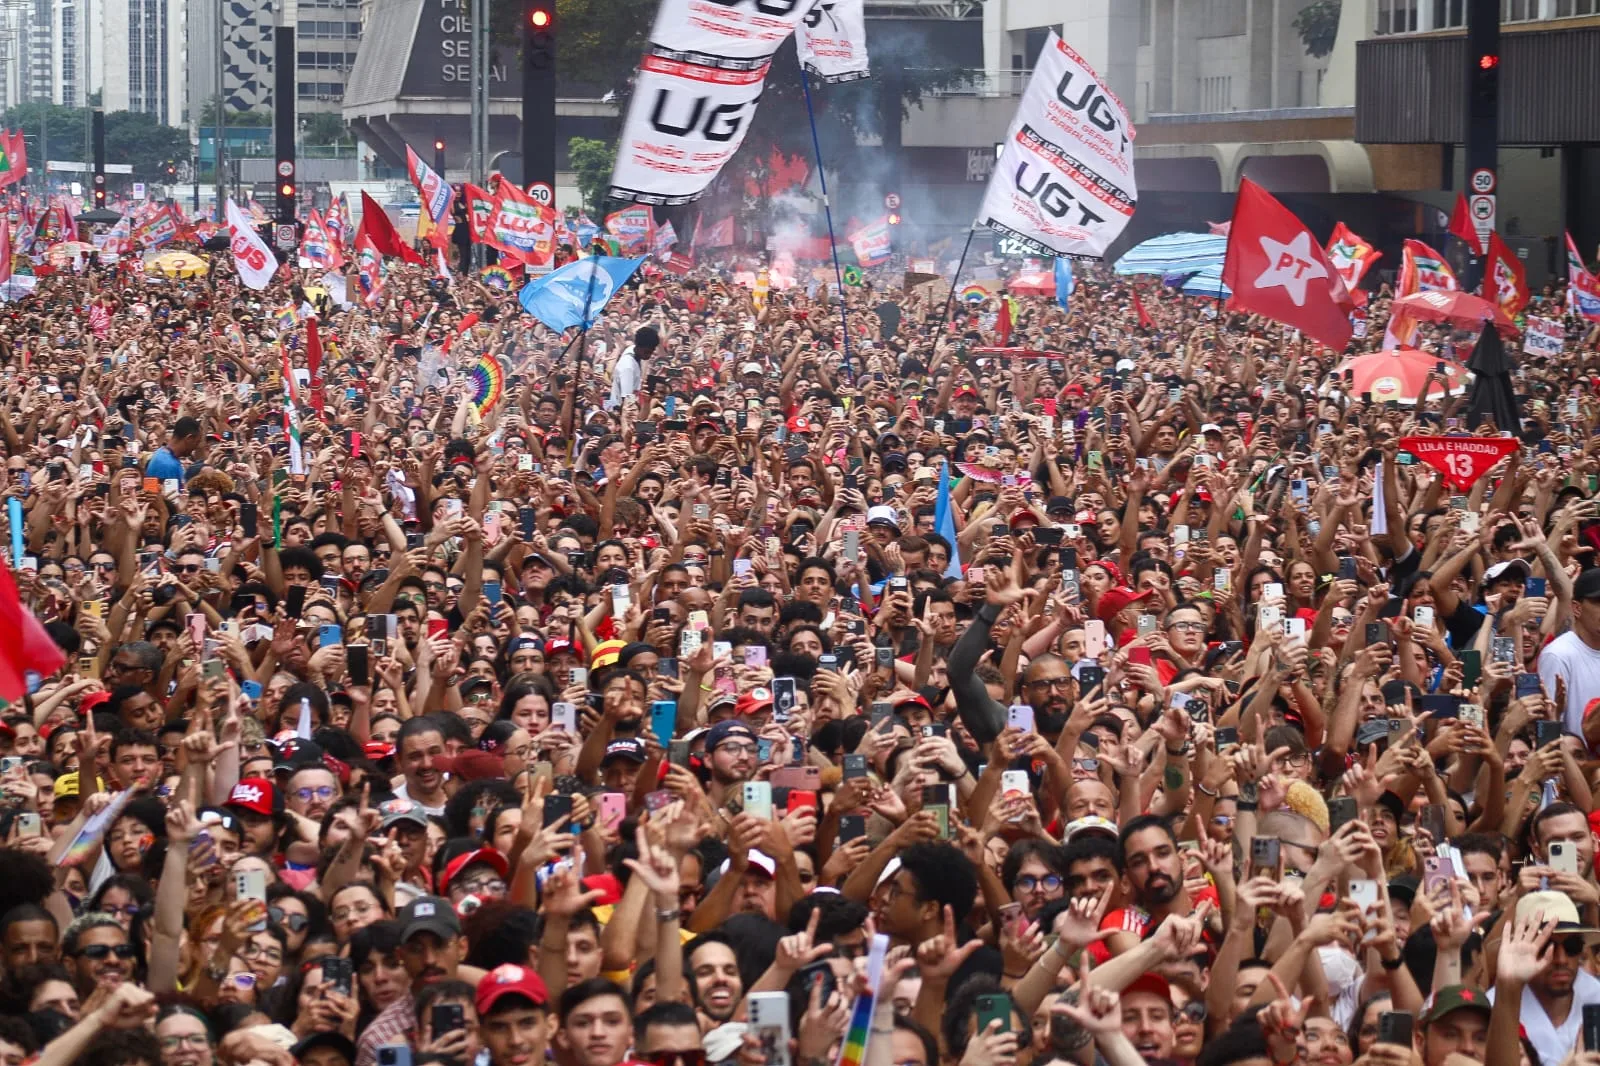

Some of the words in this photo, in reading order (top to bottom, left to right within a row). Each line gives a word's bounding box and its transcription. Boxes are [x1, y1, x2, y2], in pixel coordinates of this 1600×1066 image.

[442, 64, 507, 82] SEAI
[1047, 100, 1080, 125] UNIÃO
[1081, 124, 1115, 150] GERAL
[1062, 152, 1081, 167] UGT
[1080, 164, 1099, 179] UGT
[1097, 177, 1116, 193] UGT
[1475, 175, 1491, 186] 50
[532, 190, 548, 200] 50
[1016, 161, 1106, 226] UGT
[1090, 184, 1109, 201] UGT
[991, 222, 1010, 235] UGT
[1008, 230, 1028, 243] UGT
[1026, 239, 1045, 252] UGT
[1275, 252, 1312, 280] PT
[1417, 442, 1444, 452] LULA
[1446, 443, 1454, 451] E
[1454, 443, 1499, 455] HADDAD
[1444, 453, 1473, 478] 13
